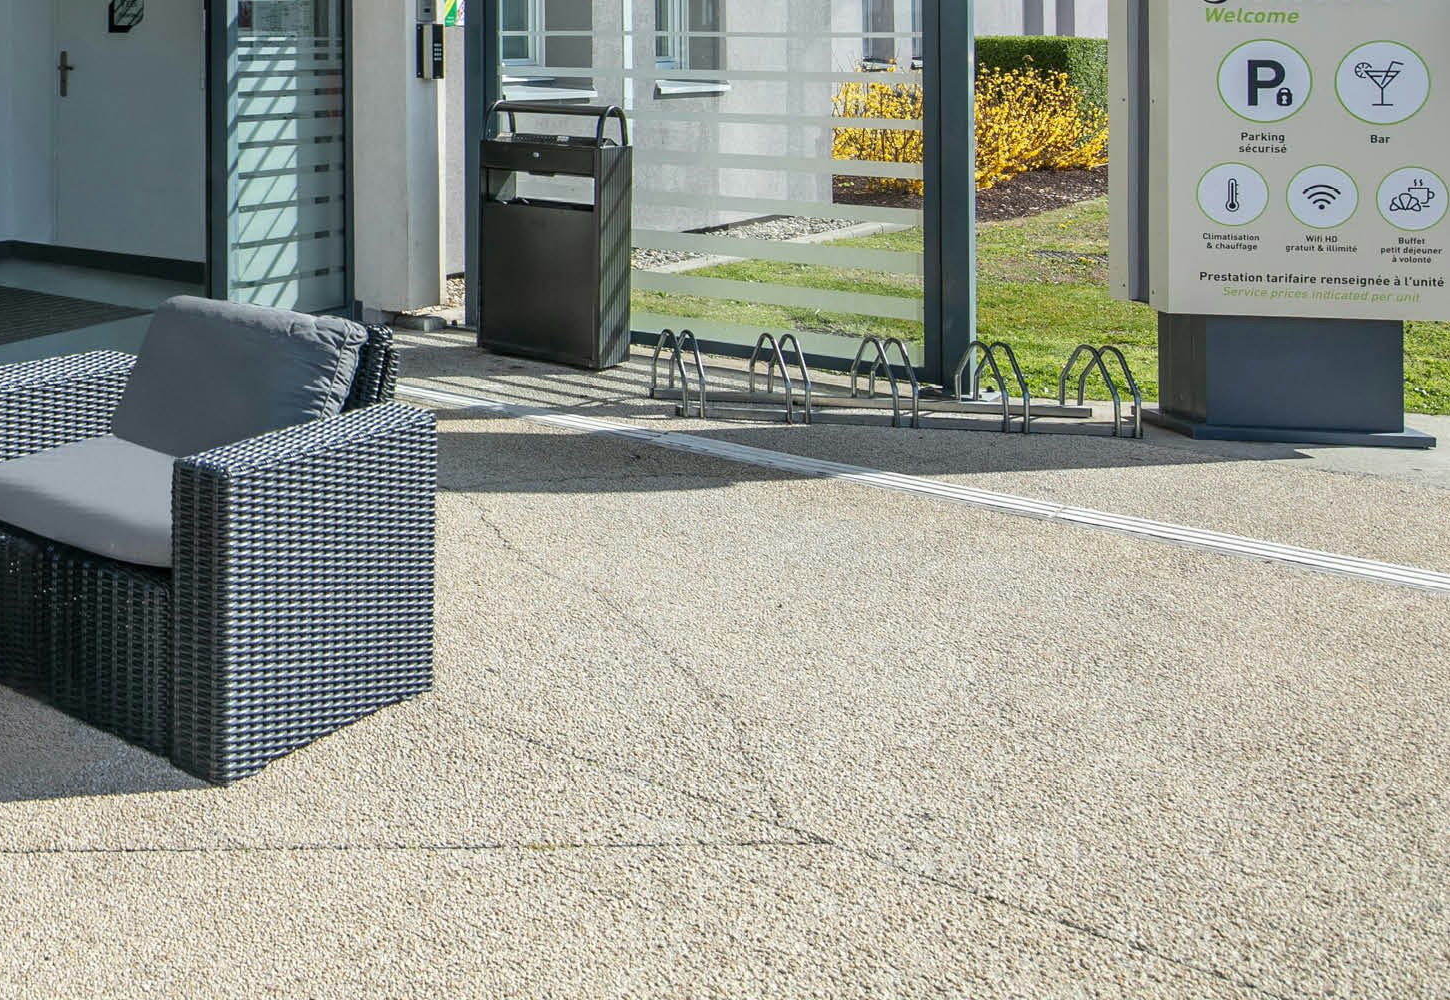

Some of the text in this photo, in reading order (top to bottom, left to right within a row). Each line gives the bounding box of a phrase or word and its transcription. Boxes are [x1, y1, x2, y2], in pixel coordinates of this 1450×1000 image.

[1205, 7, 1300, 24] Welcome
[1240, 132, 1285, 143] Parking
[1370, 134, 1391, 144] Bar
[1238, 144, 1287, 154] sécurisé
[1202, 232, 1260, 241] Climatisation
[1305, 235, 1338, 243] Wifi HD
[1398, 237, 1426, 245] Buffet
[1206, 241, 1258, 251] & chauffage
[1285, 244, 1315, 253] gratuit
[1317, 244, 1324, 252] &
[1380, 246, 1401, 256] petit
[1199, 271, 1445, 288] Prestation tarifaire renseignée à l'unité
[1222, 286, 1421, 303] Service prices indicated per unit
